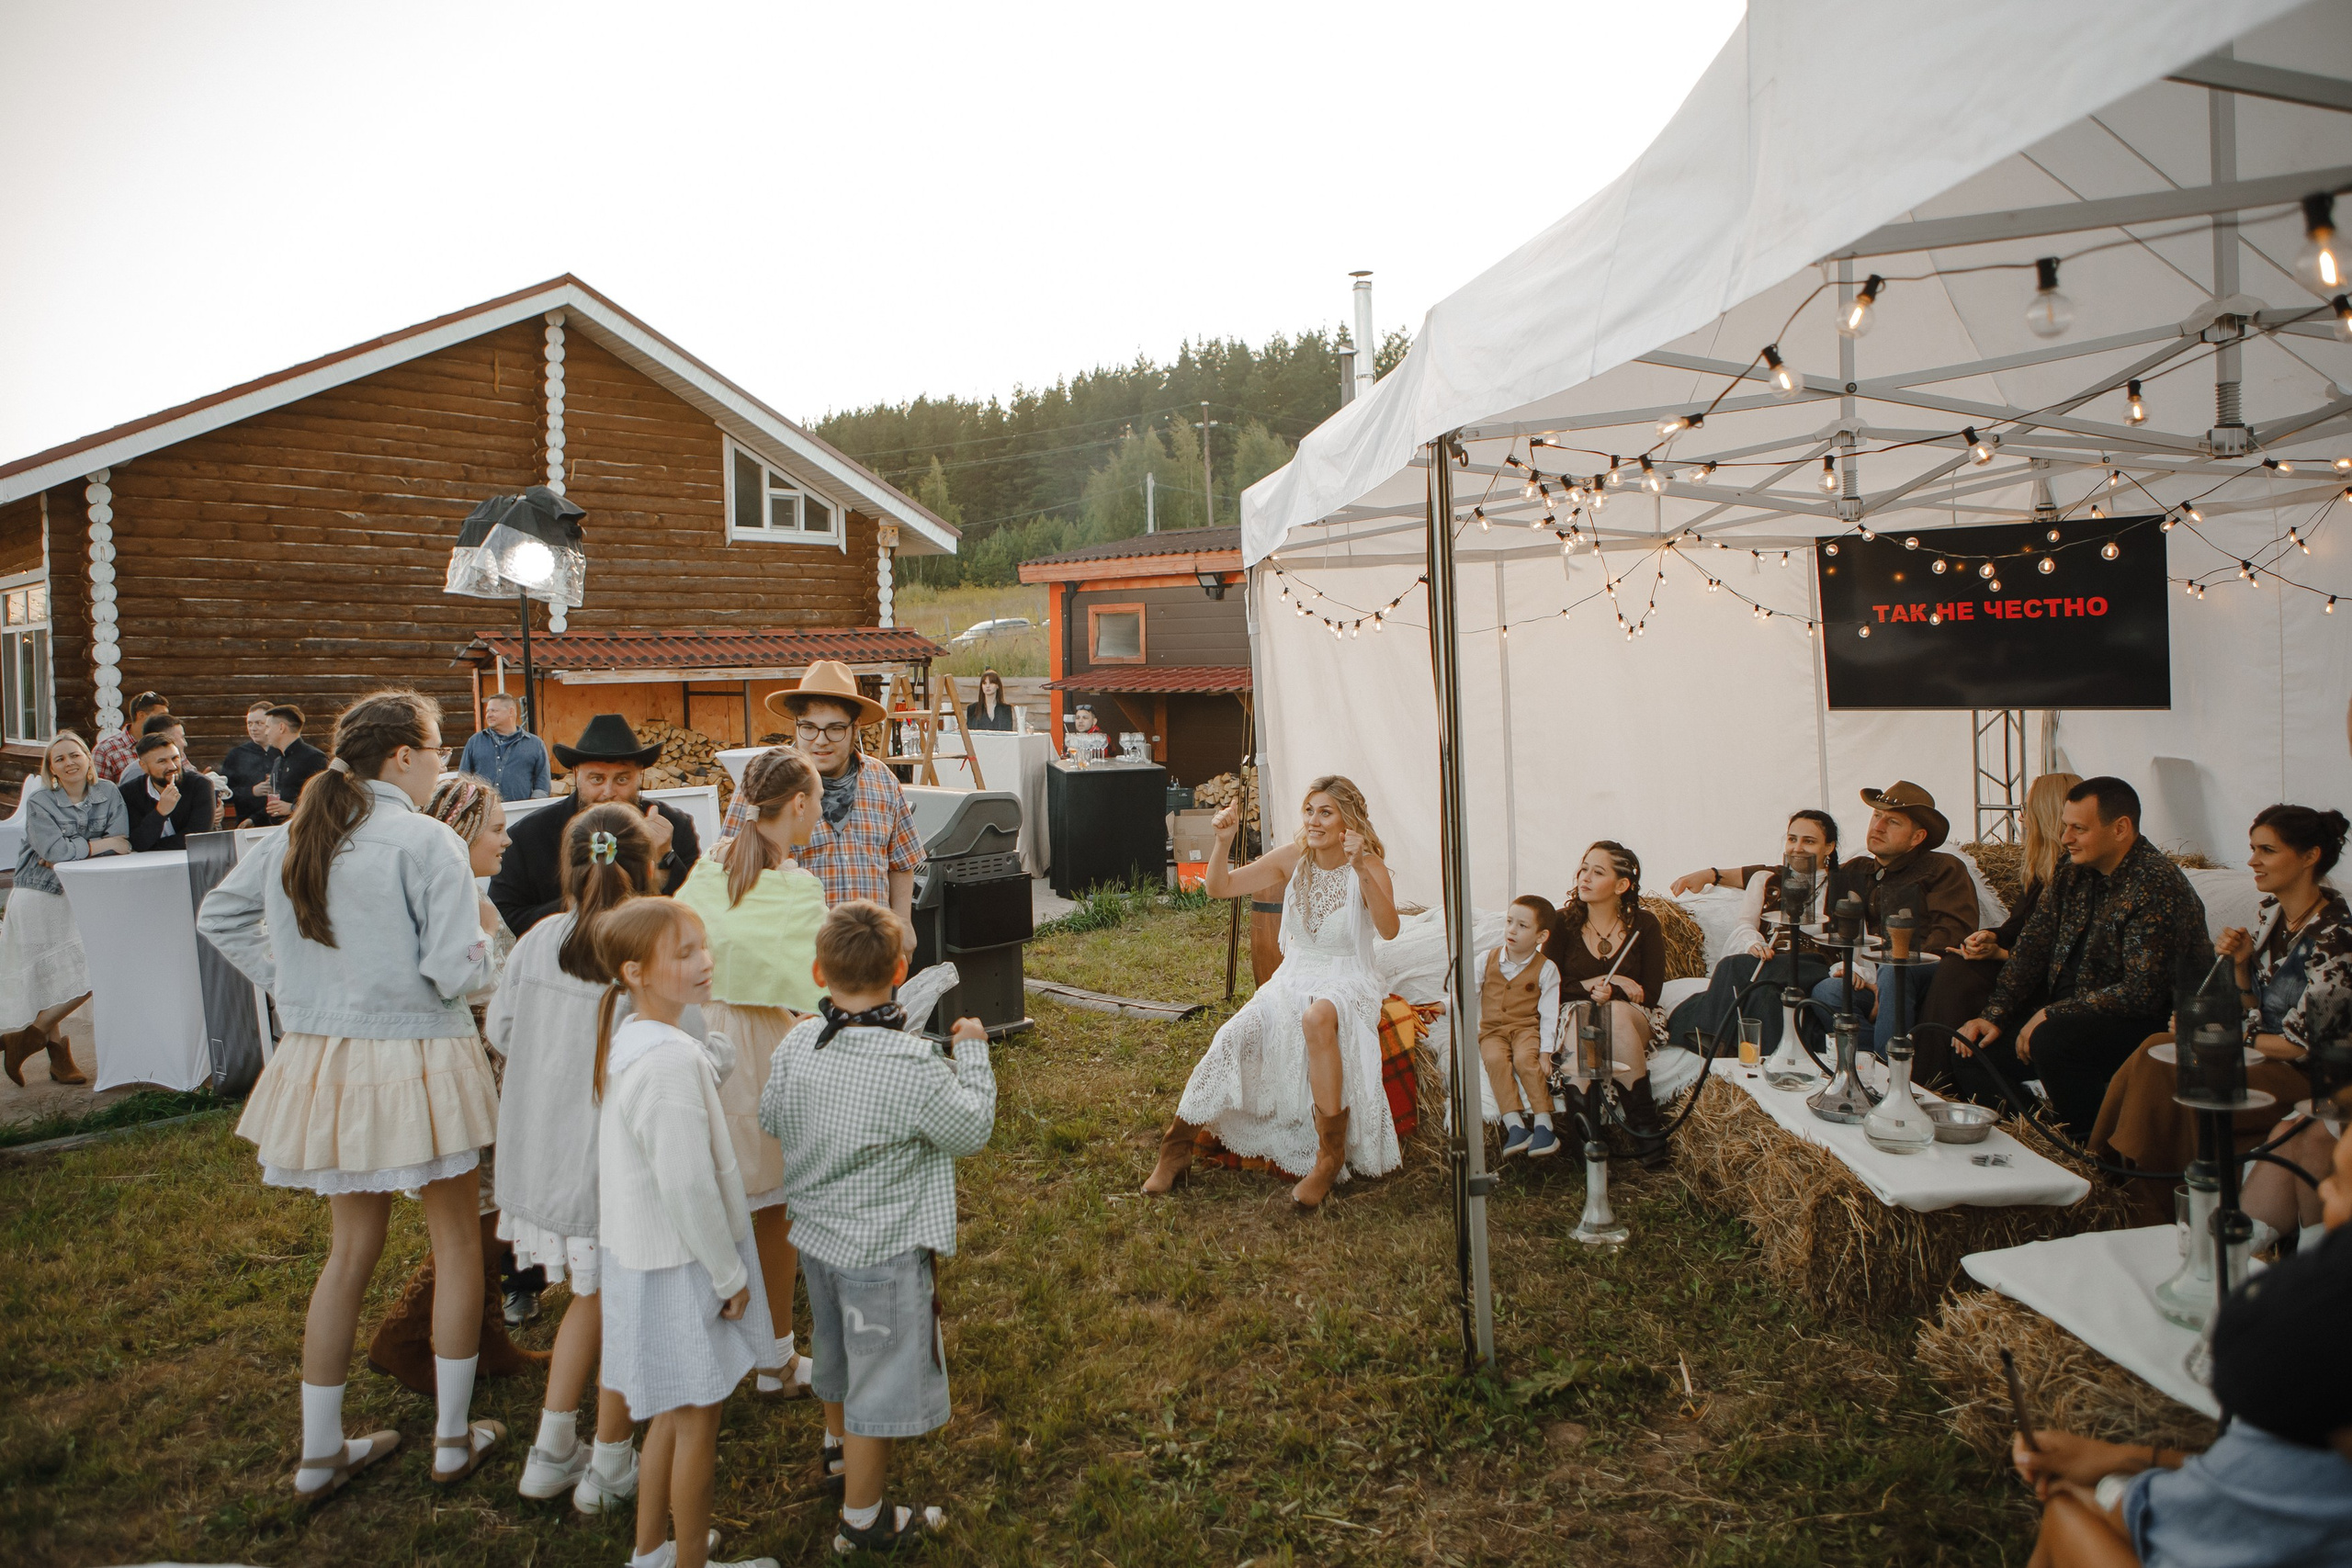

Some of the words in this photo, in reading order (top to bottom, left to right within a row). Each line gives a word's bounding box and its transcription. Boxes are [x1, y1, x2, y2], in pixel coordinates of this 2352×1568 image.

[1872, 604, 1928, 623] ТАК
[1936, 602, 1974, 621] НЕ
[1984, 596, 2109, 619] ЧЕСТНО
